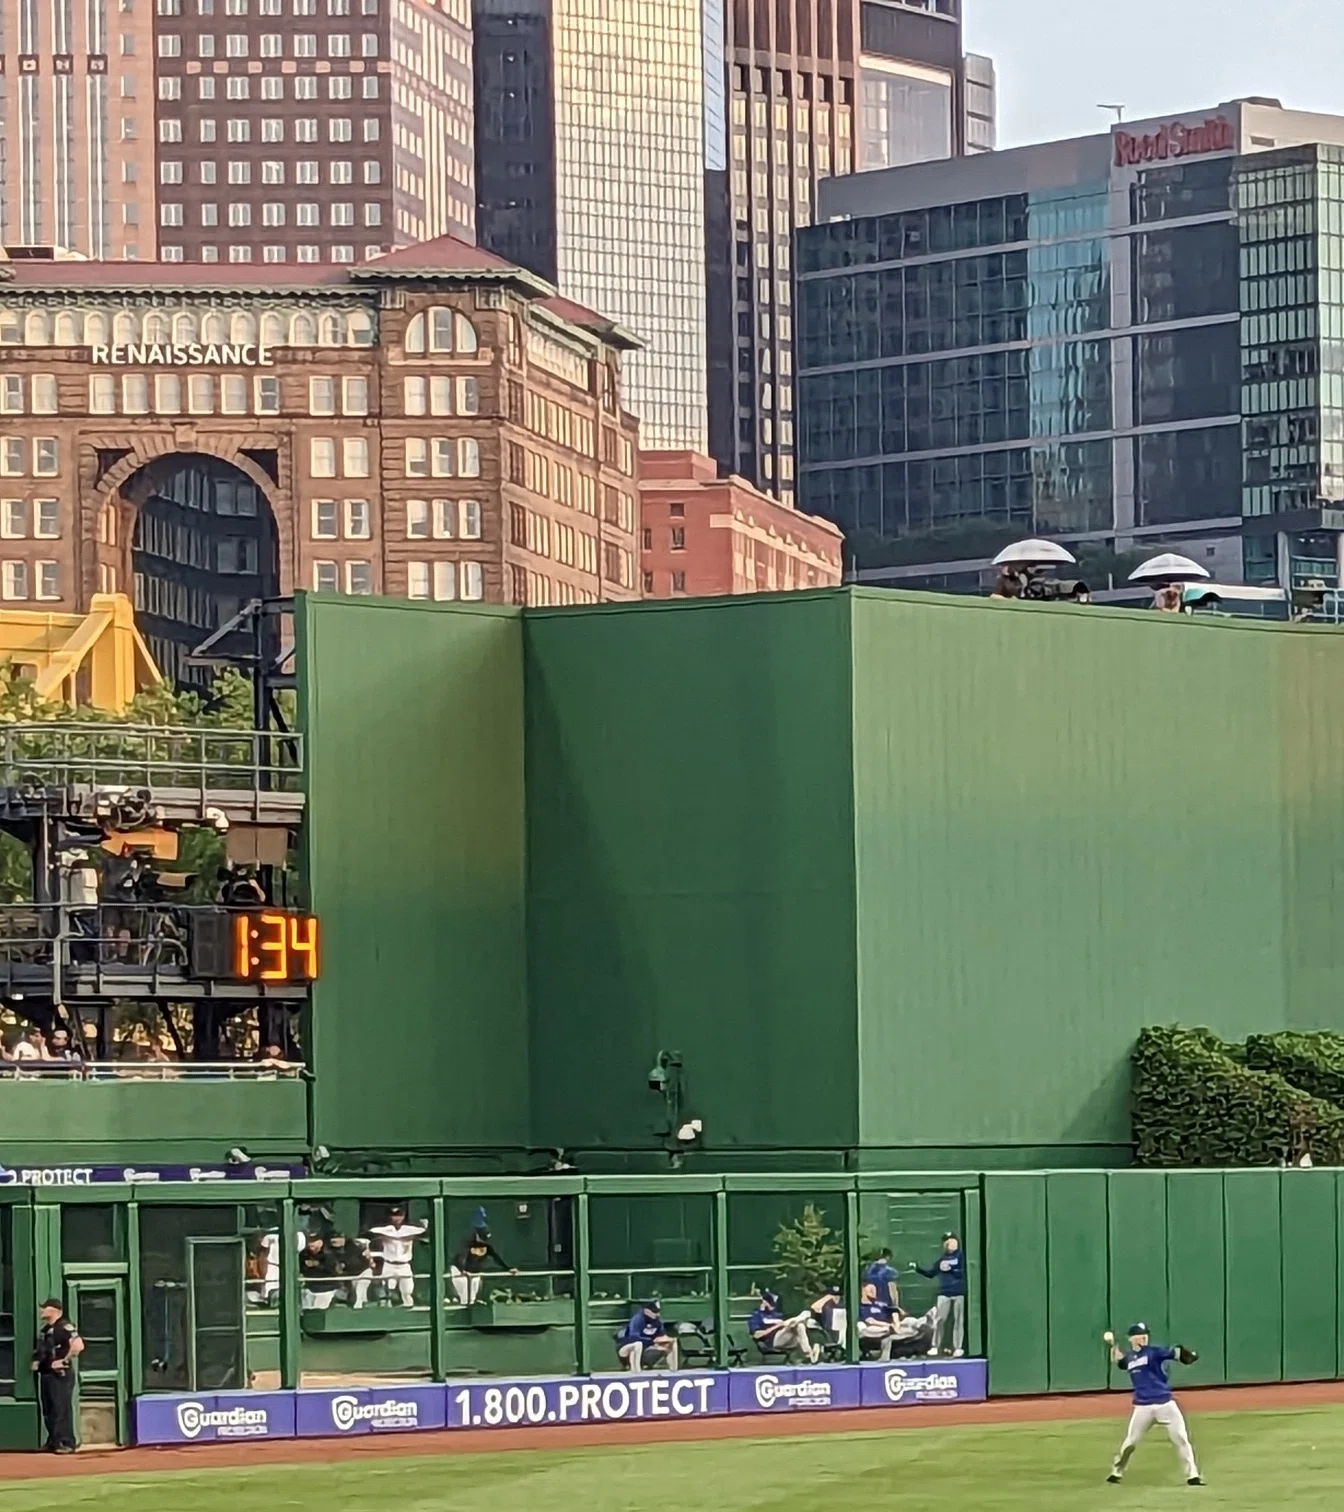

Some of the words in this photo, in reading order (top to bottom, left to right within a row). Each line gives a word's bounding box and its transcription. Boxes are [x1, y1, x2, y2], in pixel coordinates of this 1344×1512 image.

[92, 344, 273, 366] RENAISSANCE
[236, 912, 319, 980] 1:34
[334, 1398, 417, 1426] Guardian
[456, 1378, 714, 1426] 1.800.PROTECT
[180, 1404, 266, 1432] Guardian
